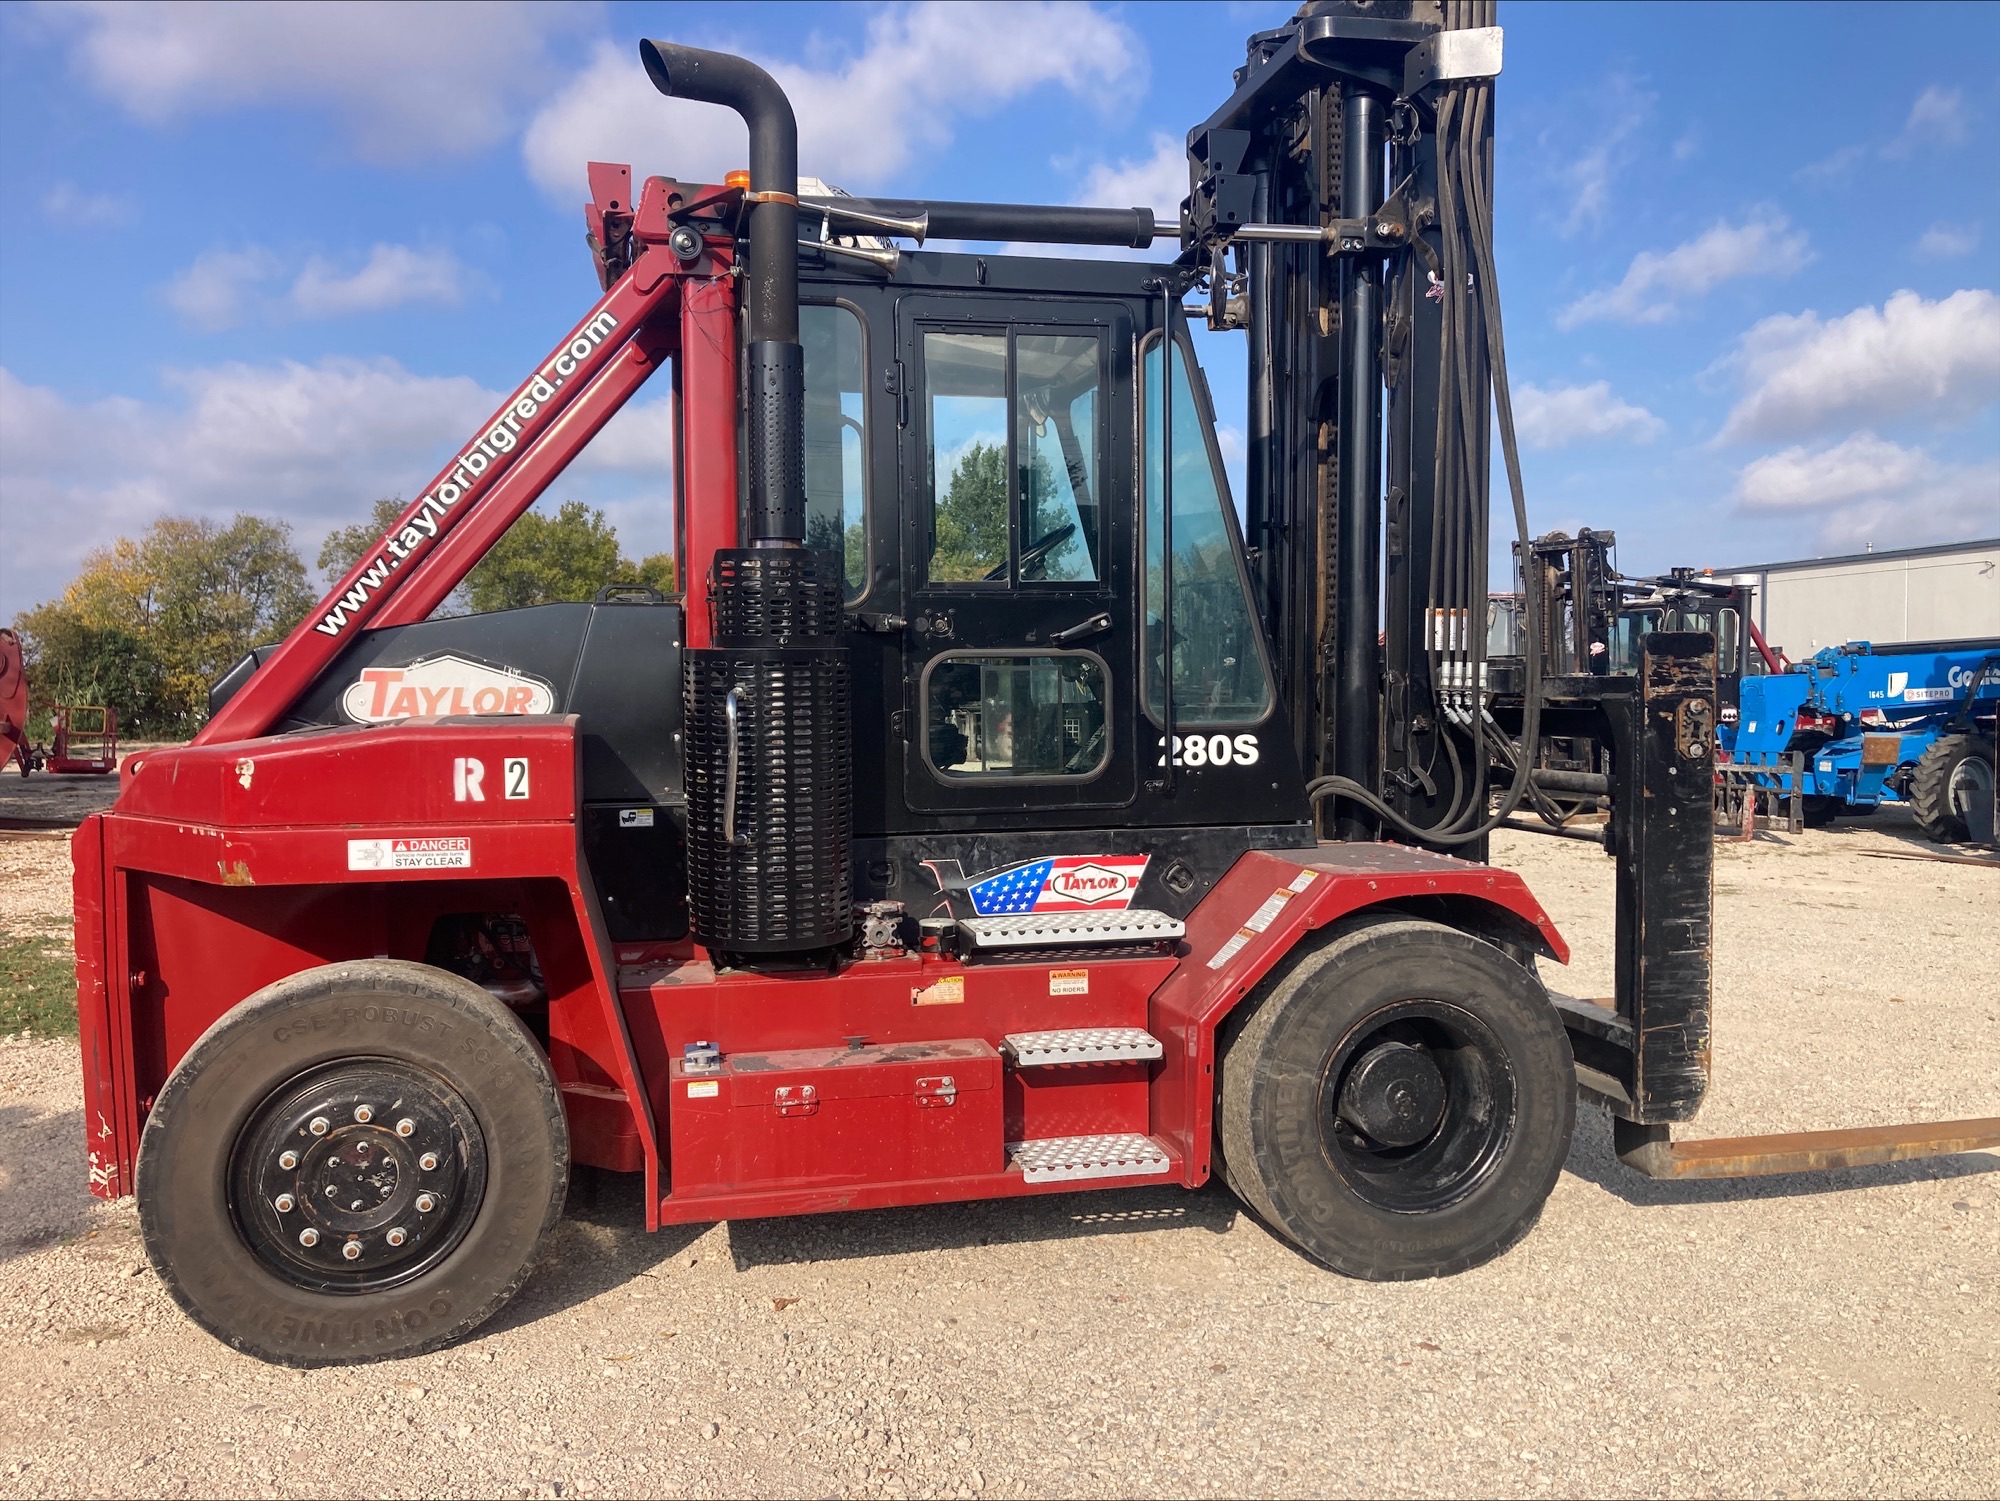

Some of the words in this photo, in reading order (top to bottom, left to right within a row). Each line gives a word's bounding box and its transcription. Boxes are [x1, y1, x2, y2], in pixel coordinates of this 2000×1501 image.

[316, 311, 618, 637] www.taylorbigred.com
[1948, 665, 2000, 688] Geie
[363, 671, 534, 718] TAYLOR
[1916, 689, 1950, 698] SITEPRO
[1158, 734, 1259, 766] 280S
[453, 757, 485, 801] R
[508, 760, 526, 797] 2
[409, 840, 467, 851] DANGER
[395, 858, 423, 867] STAY
[425, 857, 463, 866] CLEAR
[1061, 872, 1119, 890] TAYLOR
